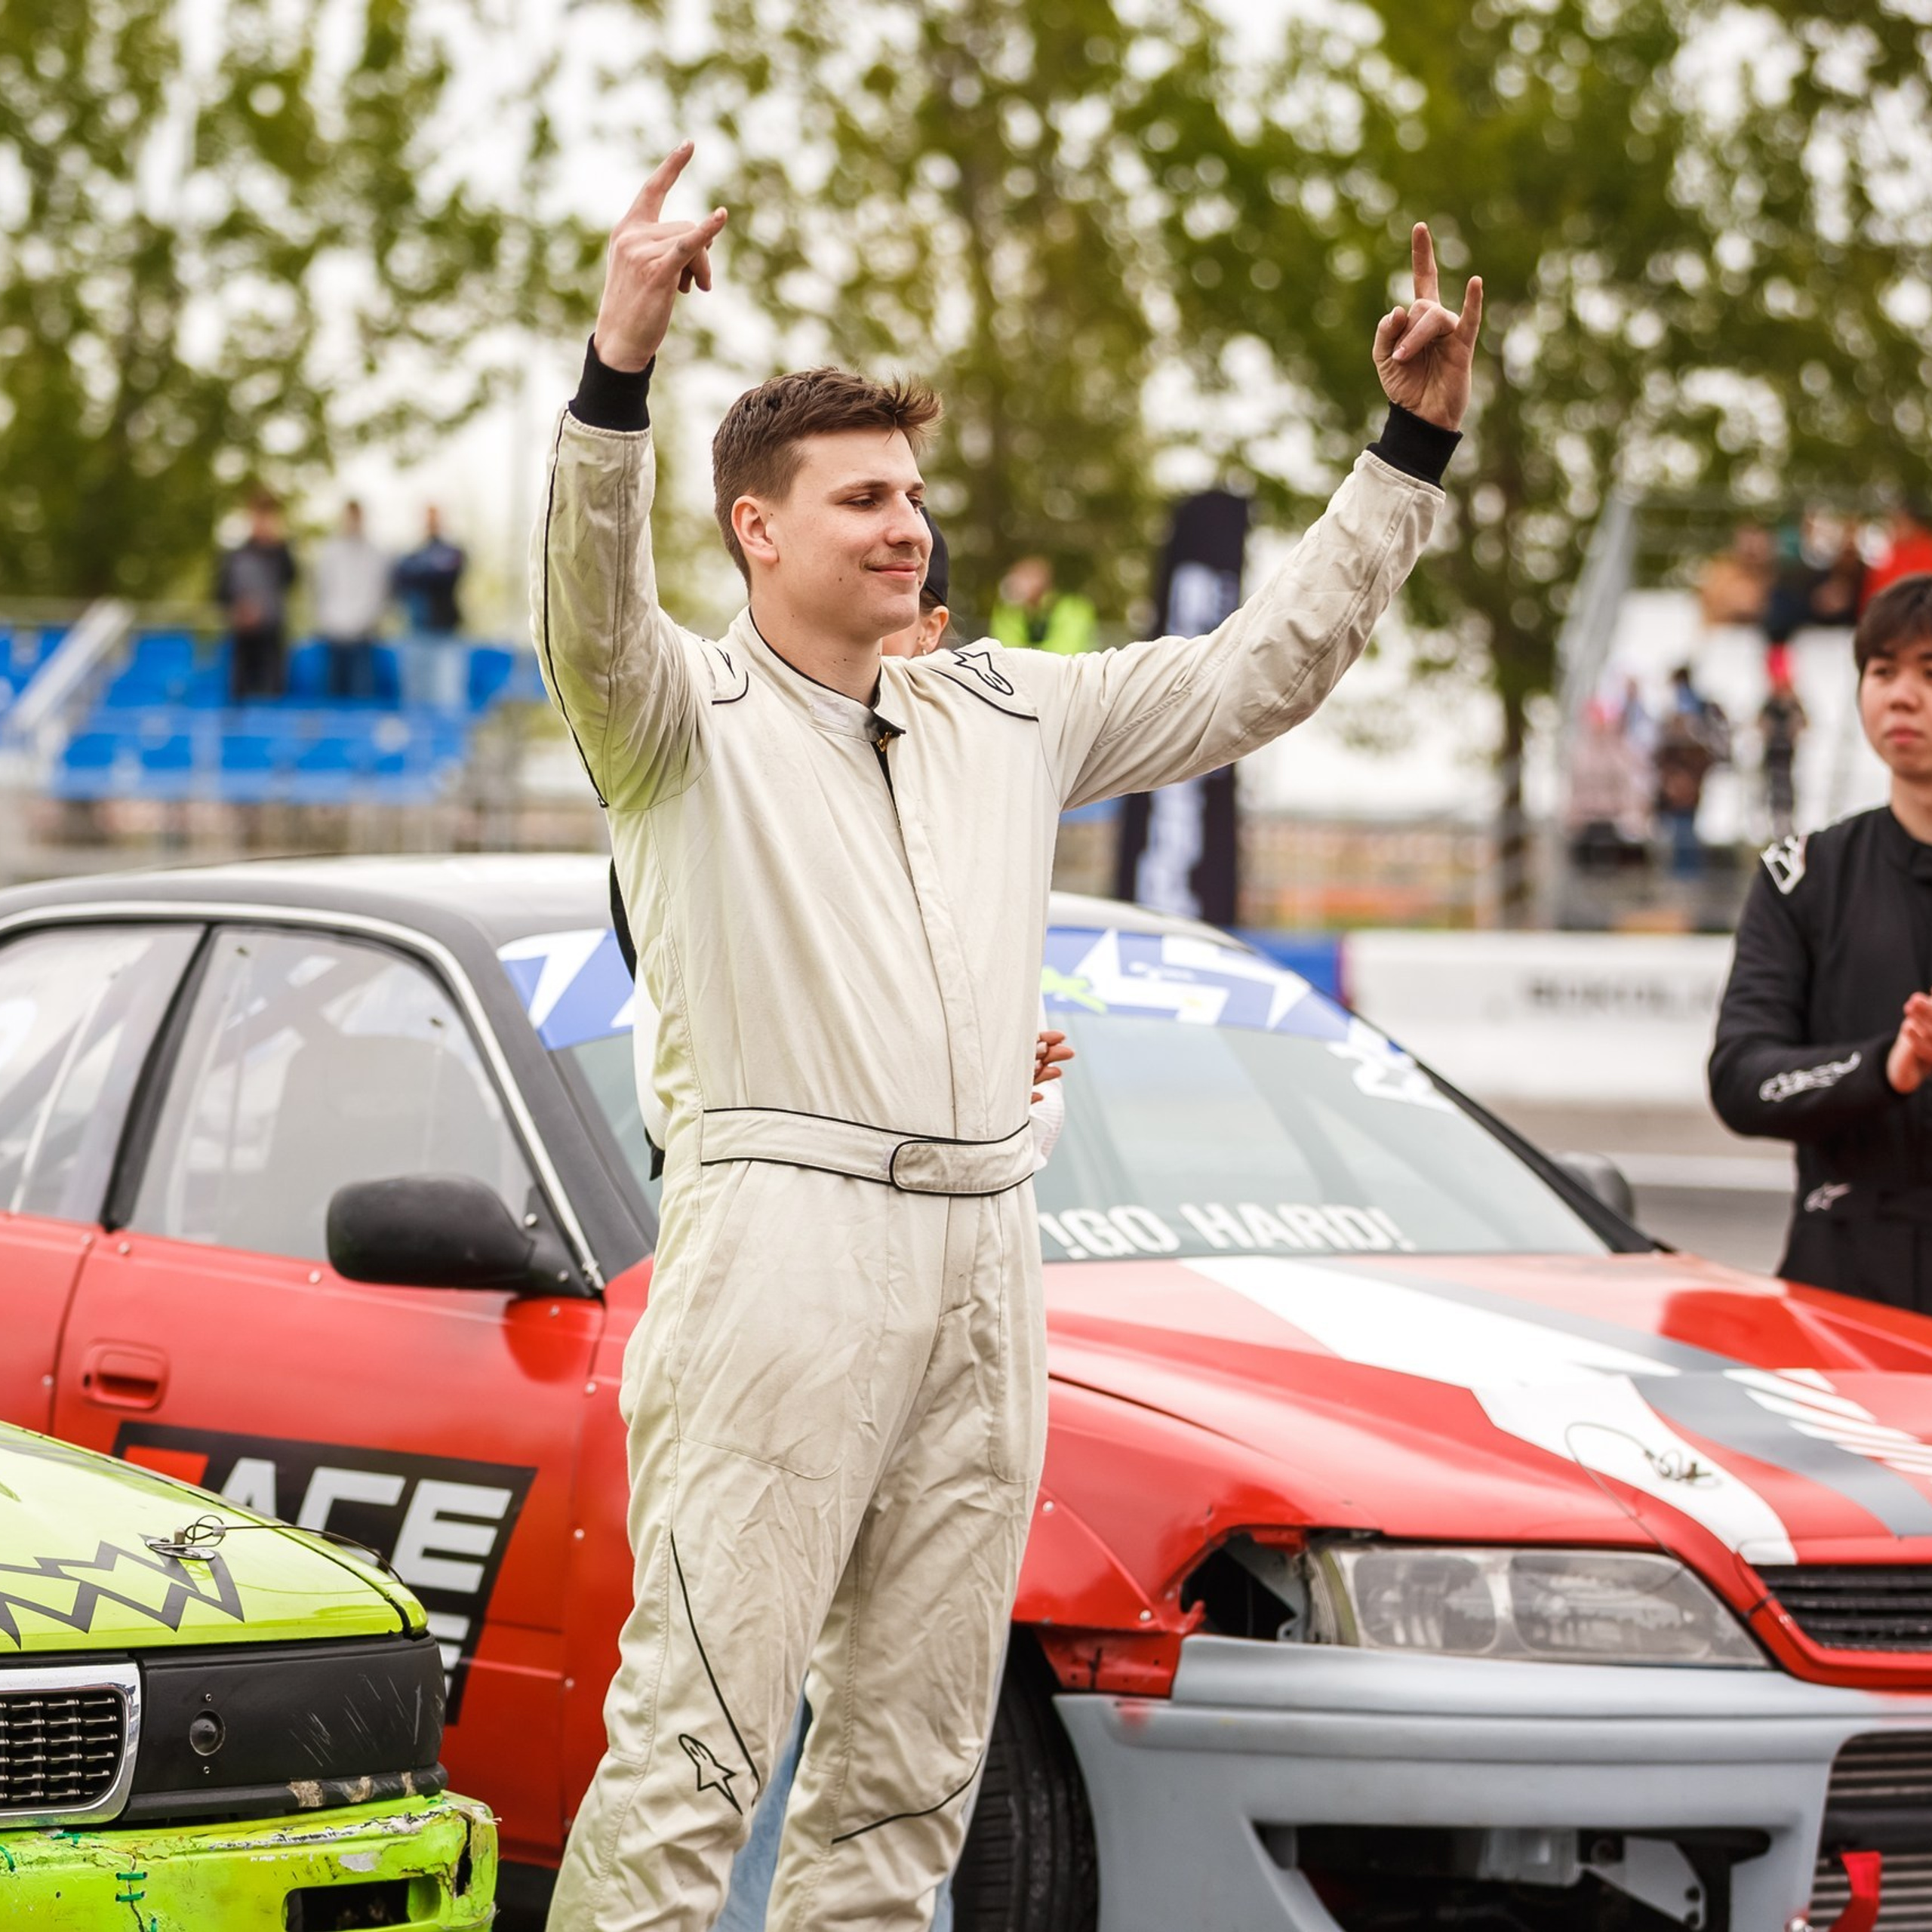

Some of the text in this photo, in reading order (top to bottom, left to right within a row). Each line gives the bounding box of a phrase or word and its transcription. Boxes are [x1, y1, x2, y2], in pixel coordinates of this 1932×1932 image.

[1039, 1203, 1416, 1260] !GO HARD!
[122, 1444, 513, 1594] ACE
